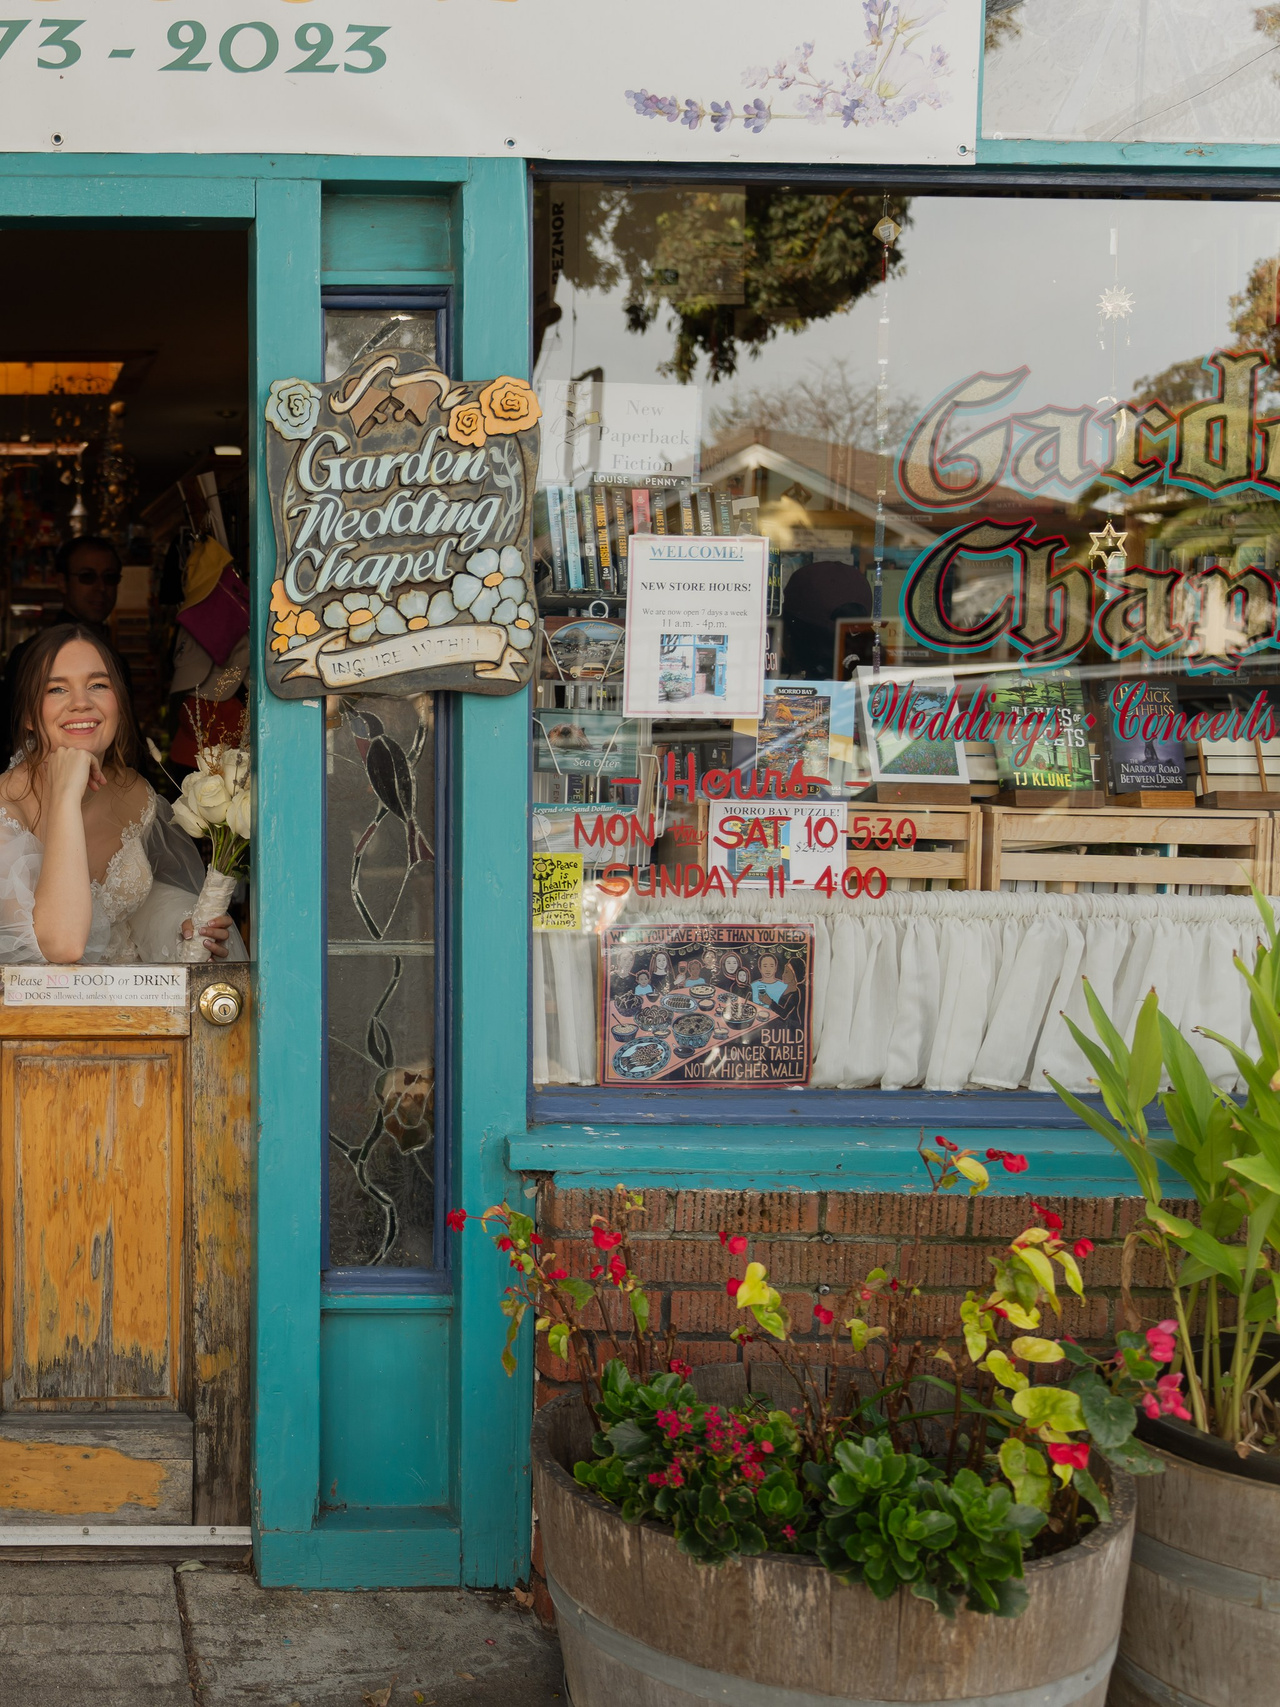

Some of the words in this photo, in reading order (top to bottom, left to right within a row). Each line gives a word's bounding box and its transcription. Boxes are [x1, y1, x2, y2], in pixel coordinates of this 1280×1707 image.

[157, 21, 393, 74] 2023
[627, 400, 664, 416] New
[597, 426, 690, 448] Paperback
[298, 425, 489, 492] Garden
[613, 454, 673, 471] Fiction
[593, 475, 629, 484] LOUISE
[645, 477, 677, 486] PENNY
[287, 489, 503, 552] Wedding
[597, 528, 612, 567] PATTERSON
[650, 545, 744, 559] WELCOME!
[285, 538, 458, 604] Chapel
[641, 582, 666, 591] NEW
[669, 582, 705, 591] STORE
[709, 582, 751, 592] HOURS!
[899, 516, 1280, 677] Chap
[662, 619, 671, 627] 11
[868, 679, 1064, 769] Weddings
[1109, 680, 1280, 745] Concerts
[573, 757, 591, 767] Sea
[593, 758, 620, 769] Otter
[1121, 764, 1157, 773] NARROW
[1159, 764, 1180, 773] ROAD
[663, 751, 832, 802] Hours
[1014, 772, 1028, 785] TJ
[1032, 772, 1072, 787] KLUNE
[1121, 774, 1155, 784] BETWEEN
[1156, 774, 1183, 784] DESIRES
[723, 806, 765, 816] MORRO
[768, 807, 791, 816] BAY
[794, 808, 840, 817] PUZZLE!
[574, 813, 655, 849] MON
[713, 816, 792, 849] SAT
[556, 860, 578, 870] Peace
[543, 879, 578, 891] healthy
[596, 863, 753, 898] SUNDAY
[767, 865, 784, 898] 11
[814, 865, 888, 899] 4:00
[545, 892, 578, 902] children
[610, 930, 643, 942] WHEN
[647, 930, 665, 942] YOU
[667, 930, 693, 942] HAVE
[694, 930, 724, 942] MORE
[726, 930, 755, 942] THAN
[756, 930, 775, 942] YOU
[778, 930, 806, 942] NEED
[10, 974, 42, 986] Please
[46, 974, 69, 988] NO
[73, 974, 114, 986] FOOD
[118, 977, 130, 986] or
[134, 974, 180, 986] DRINK
[7, 992, 22, 1000] NO
[25, 991, 51, 1000] DOGS
[53, 991, 84, 1001] allowed,
[85, 991, 107, 1000] unless
[109, 993, 122, 1001] you
[140, 993, 159, 1001] carry
[161, 991, 183, 1000] them.
[760, 1028, 804, 1044] BUILD
[723, 1046, 766, 1061] LONGER
[769, 1045, 804, 1060] TABLE
[684, 1063, 707, 1078] NOT
[709, 1064, 716, 1077] A
[721, 1062, 769, 1078] HIGHER
[771, 1062, 803, 1077] WALL
